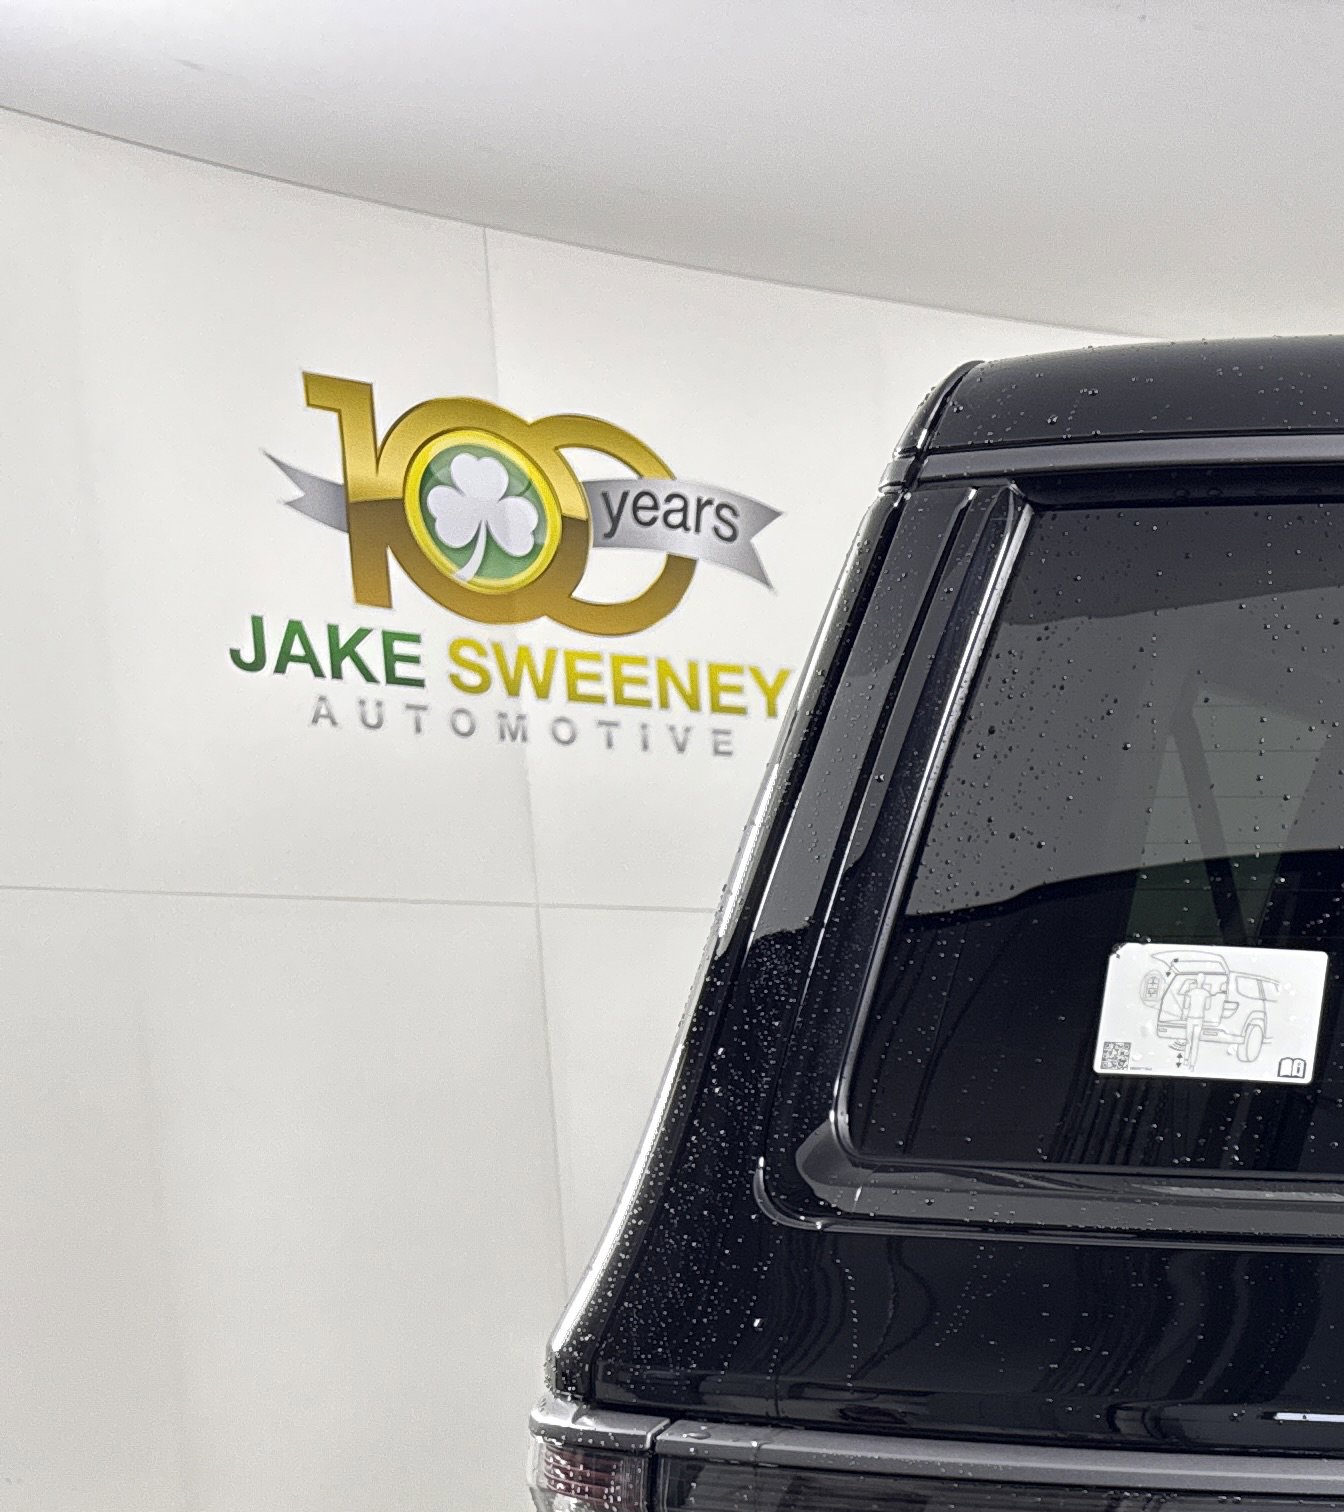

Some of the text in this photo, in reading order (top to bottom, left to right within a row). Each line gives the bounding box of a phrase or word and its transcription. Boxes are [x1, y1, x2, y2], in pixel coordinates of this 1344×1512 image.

[302, 372, 741, 638] 100 years
[229, 614, 792, 718] JAKE SWEENEY
[310, 695, 735, 757] AUTOMOTIVE
